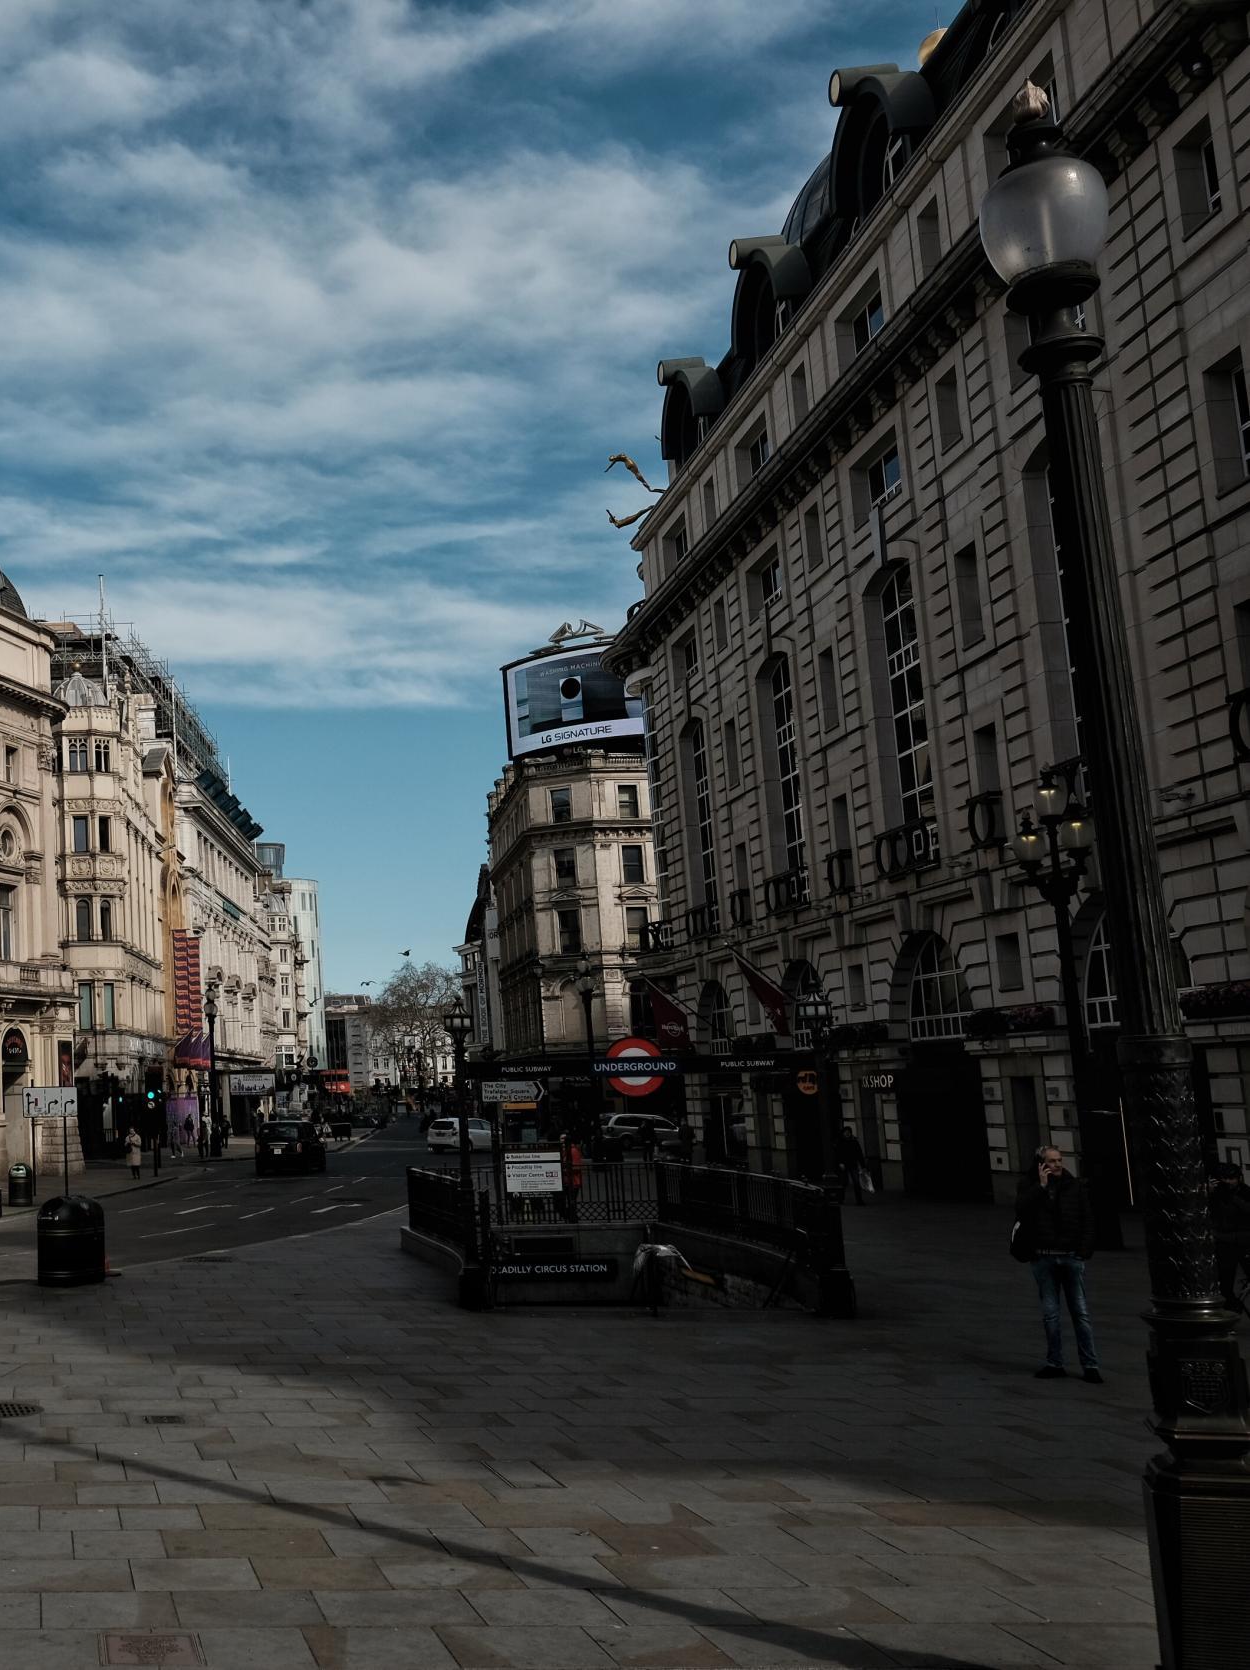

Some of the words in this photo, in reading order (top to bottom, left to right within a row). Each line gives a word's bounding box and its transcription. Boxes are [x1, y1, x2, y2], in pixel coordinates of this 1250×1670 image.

[540, 666, 568, 677] WASHING
[570, 661, 601, 670] MACHIN
[541, 734, 552, 744] LG
[554, 725, 612, 741] SIGNATURE
[477, 962, 485, 994] MORMON
[594, 1062, 676, 1072] UNDERGROUND
[870, 1074, 894, 1088] SHOP
[534, 1264, 568, 1274] CIRCUS
[569, 1264, 608, 1273] STATION
